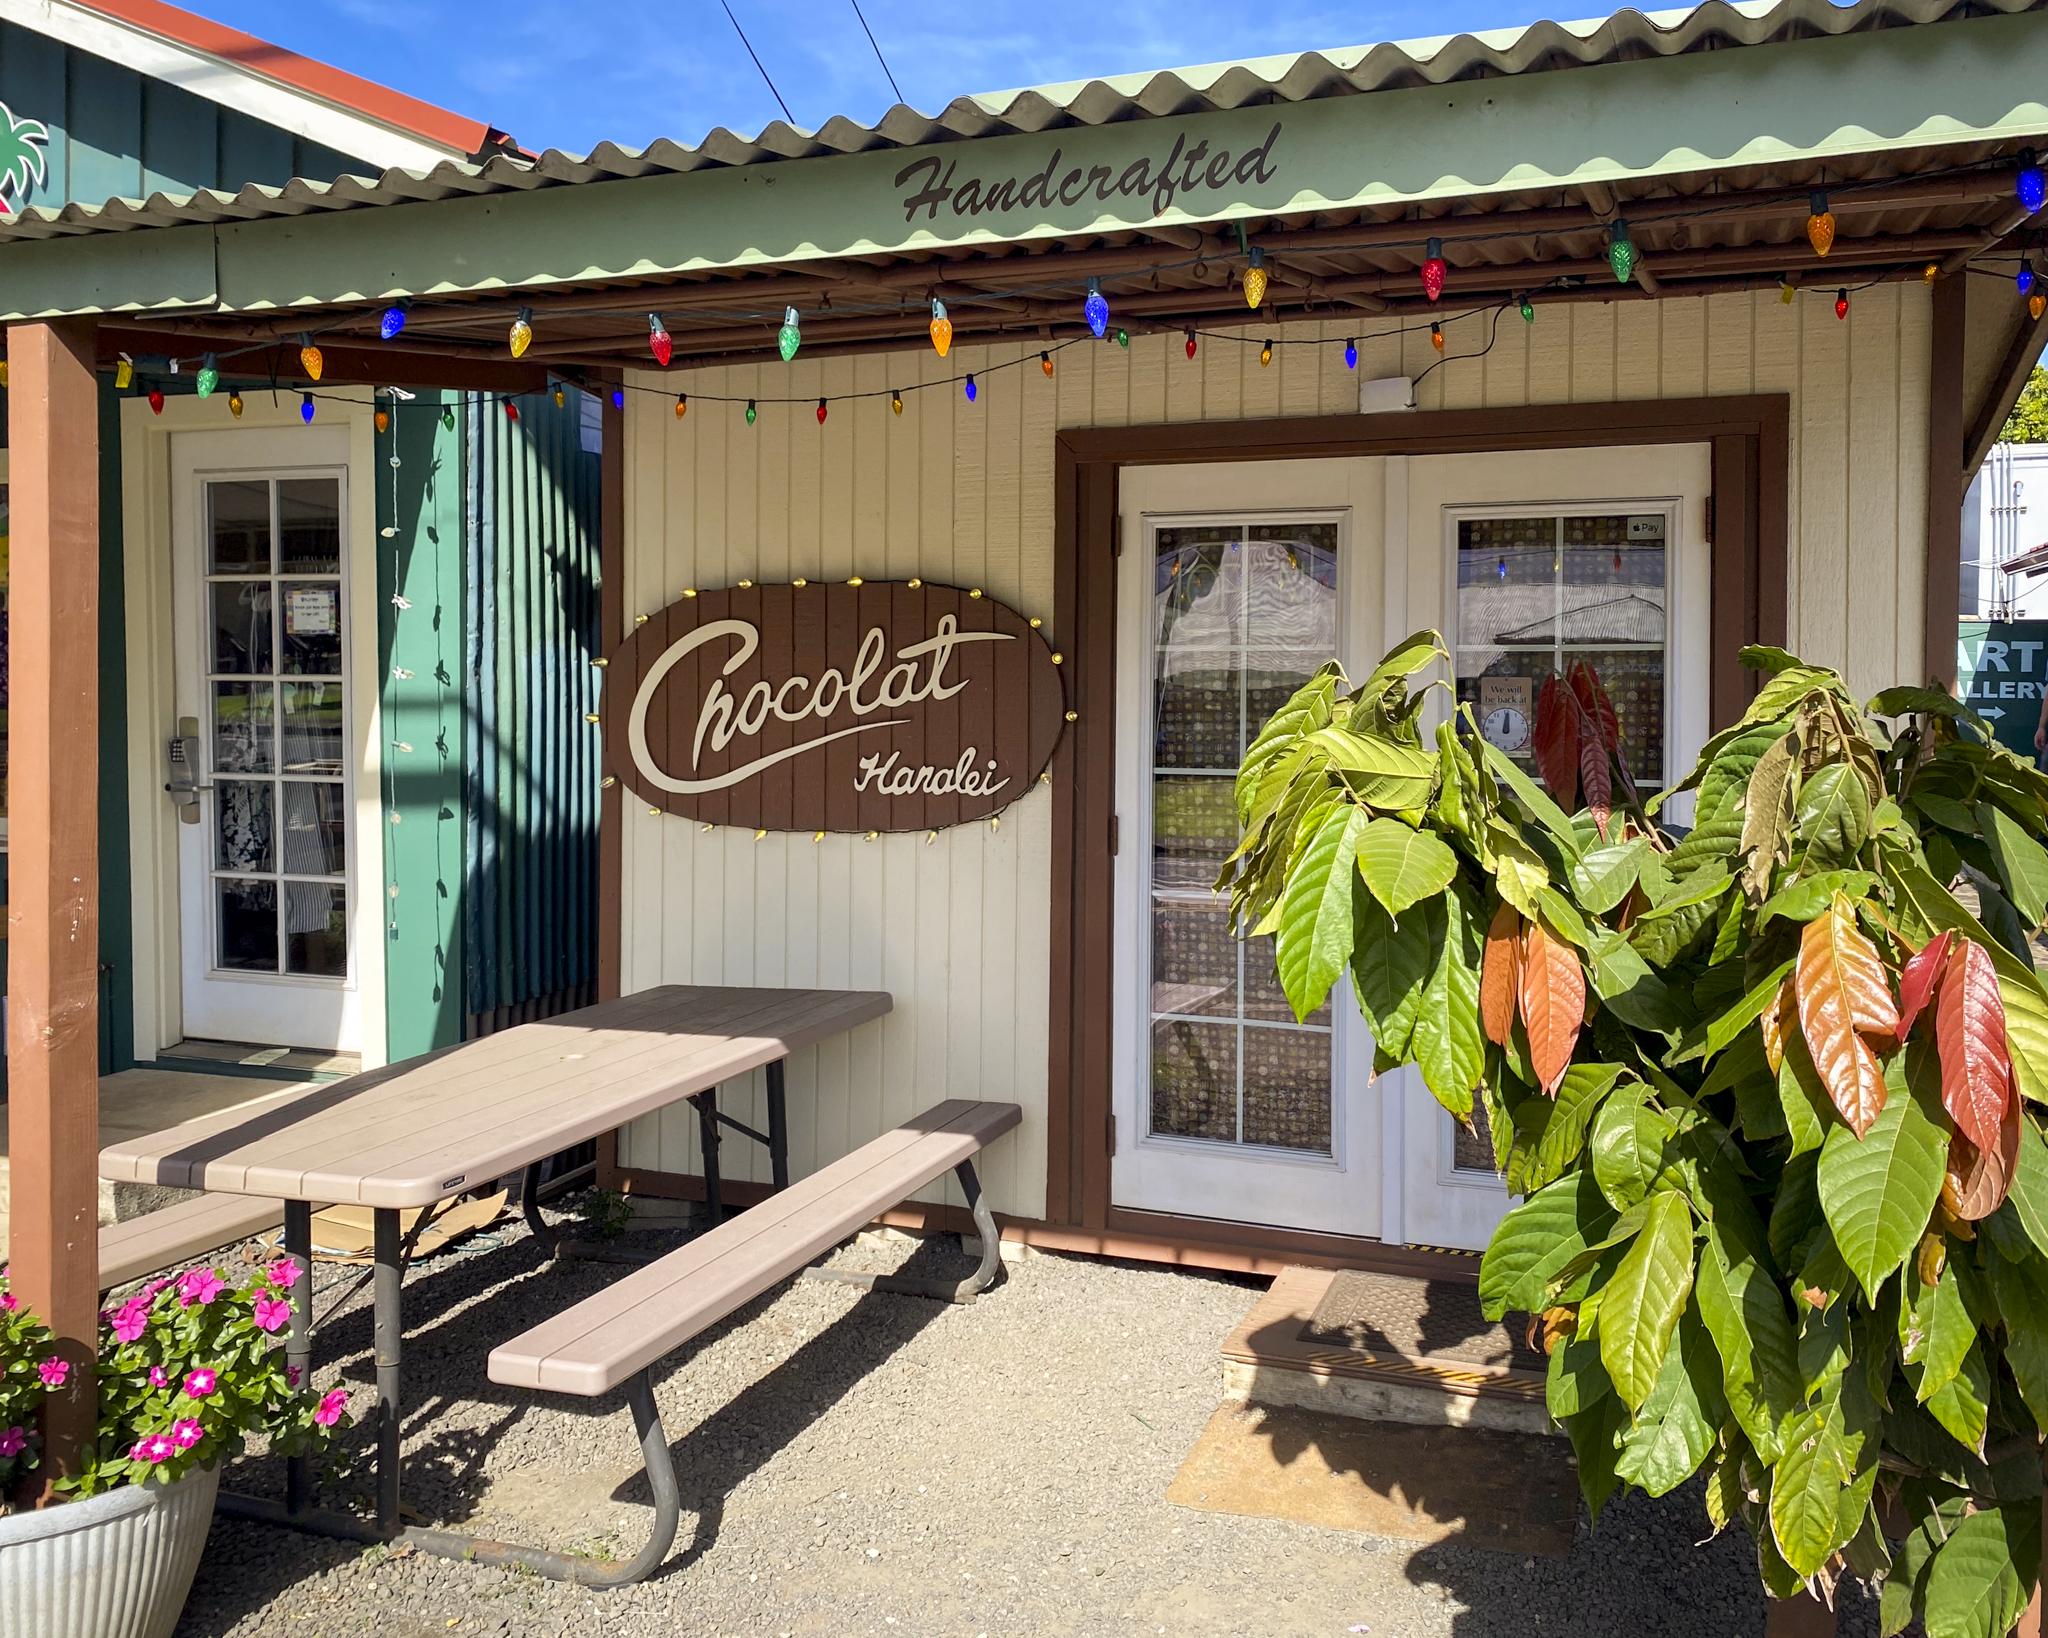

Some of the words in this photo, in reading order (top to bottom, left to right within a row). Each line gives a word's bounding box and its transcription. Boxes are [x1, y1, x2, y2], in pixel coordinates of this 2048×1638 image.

[894, 122, 1283, 222] Handcrafted
[1642, 523, 1659, 533] Pay
[628, 614, 1017, 794] Chocolat
[1485, 695, 1495, 704] be
[1497, 695, 1517, 704] back
[1490, 685, 1505, 693] We
[1506, 685, 1522, 693] will
[853, 746, 1011, 797] Hanalei
